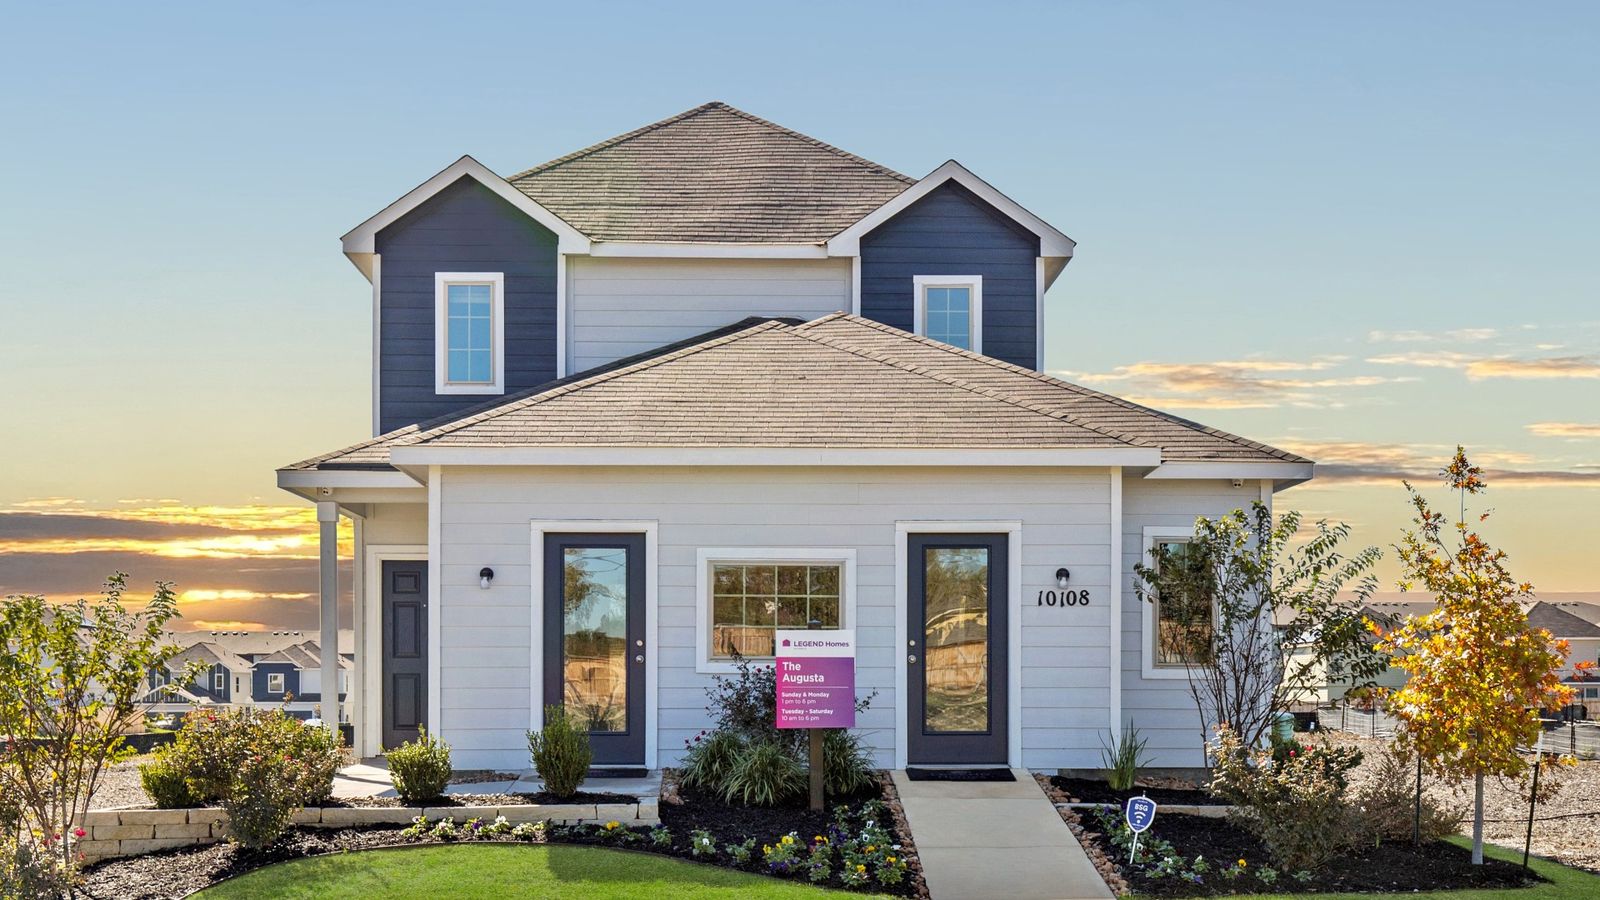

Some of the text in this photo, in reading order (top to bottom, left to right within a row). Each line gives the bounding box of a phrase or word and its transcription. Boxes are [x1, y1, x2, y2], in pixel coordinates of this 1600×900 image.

[1038, 590, 1090, 607] 10108
[782, 661, 801, 671] The
[782, 673, 824, 684] Augusta
